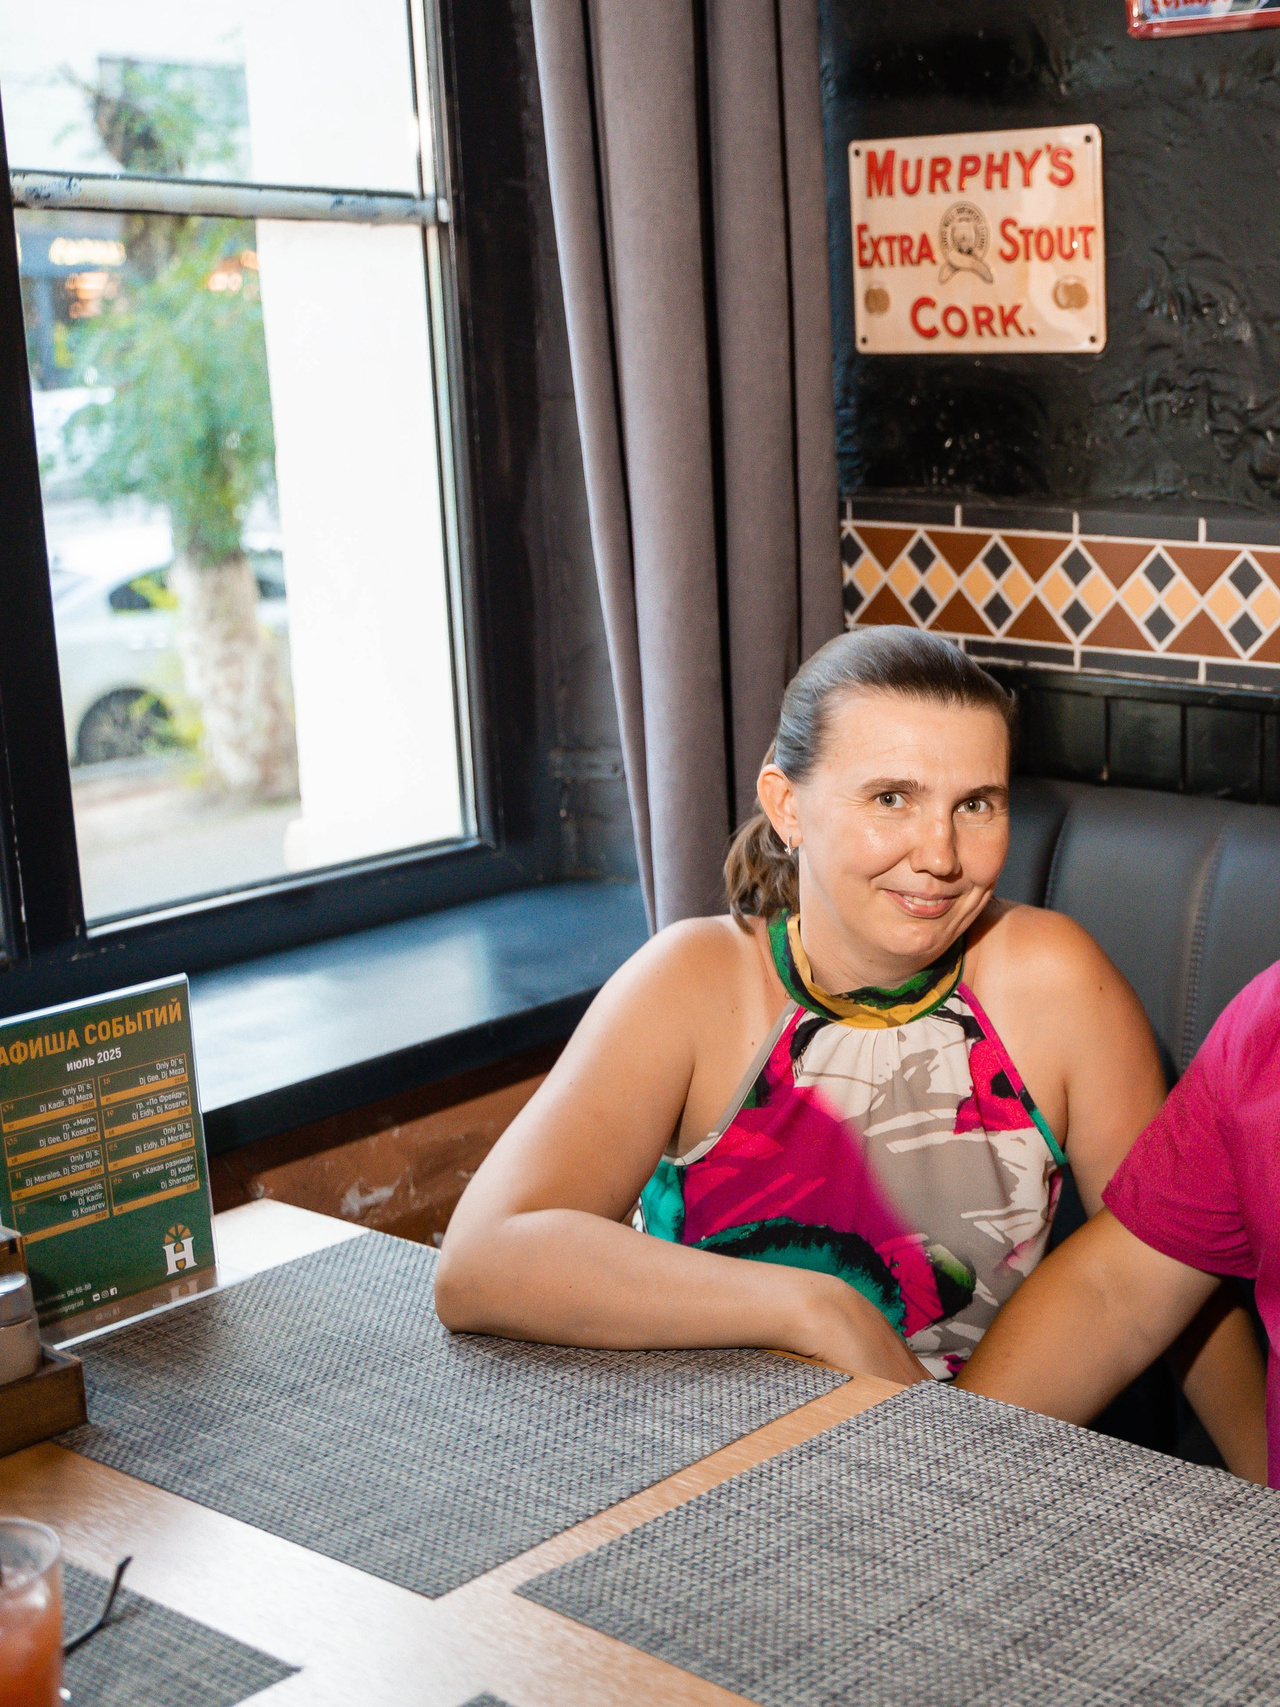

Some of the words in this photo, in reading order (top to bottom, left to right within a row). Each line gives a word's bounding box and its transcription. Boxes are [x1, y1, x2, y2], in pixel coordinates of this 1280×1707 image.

[865, 144, 1075, 197] MURPHY'S
[856, 223, 937, 269] EXTRA
[999, 217, 1095, 262] STOUT
[910, 297, 1036, 339] CORK.
[0, 1029, 80, 1066] АФИША
[84, 998, 183, 1045] СОБЫТИЙ
[97, 1047, 122, 1064] 2025
[156, 1060, 169, 1071] Only
[139, 1077, 146, 1085] Dj
[161, 1071, 168, 1079] Dj
[62, 1086, 77, 1097] Only
[40, 1104, 47, 1113] Dj
[68, 1097, 75, 1105] Dj
[132, 1112, 139, 1121] Dj
[156, 1105, 163, 1114] Dj
[163, 1126, 176, 1135] Only
[39, 1139, 46, 1147] Dj
[63, 1132, 70, 1141] Dj
[70, 1154, 84, 1163] Only
[25, 1178, 33, 1187] Dj
[63, 1167, 70, 1176] Dj
[78, 1197, 85, 1206] Dj
[72, 1209, 79, 1218] Dj
